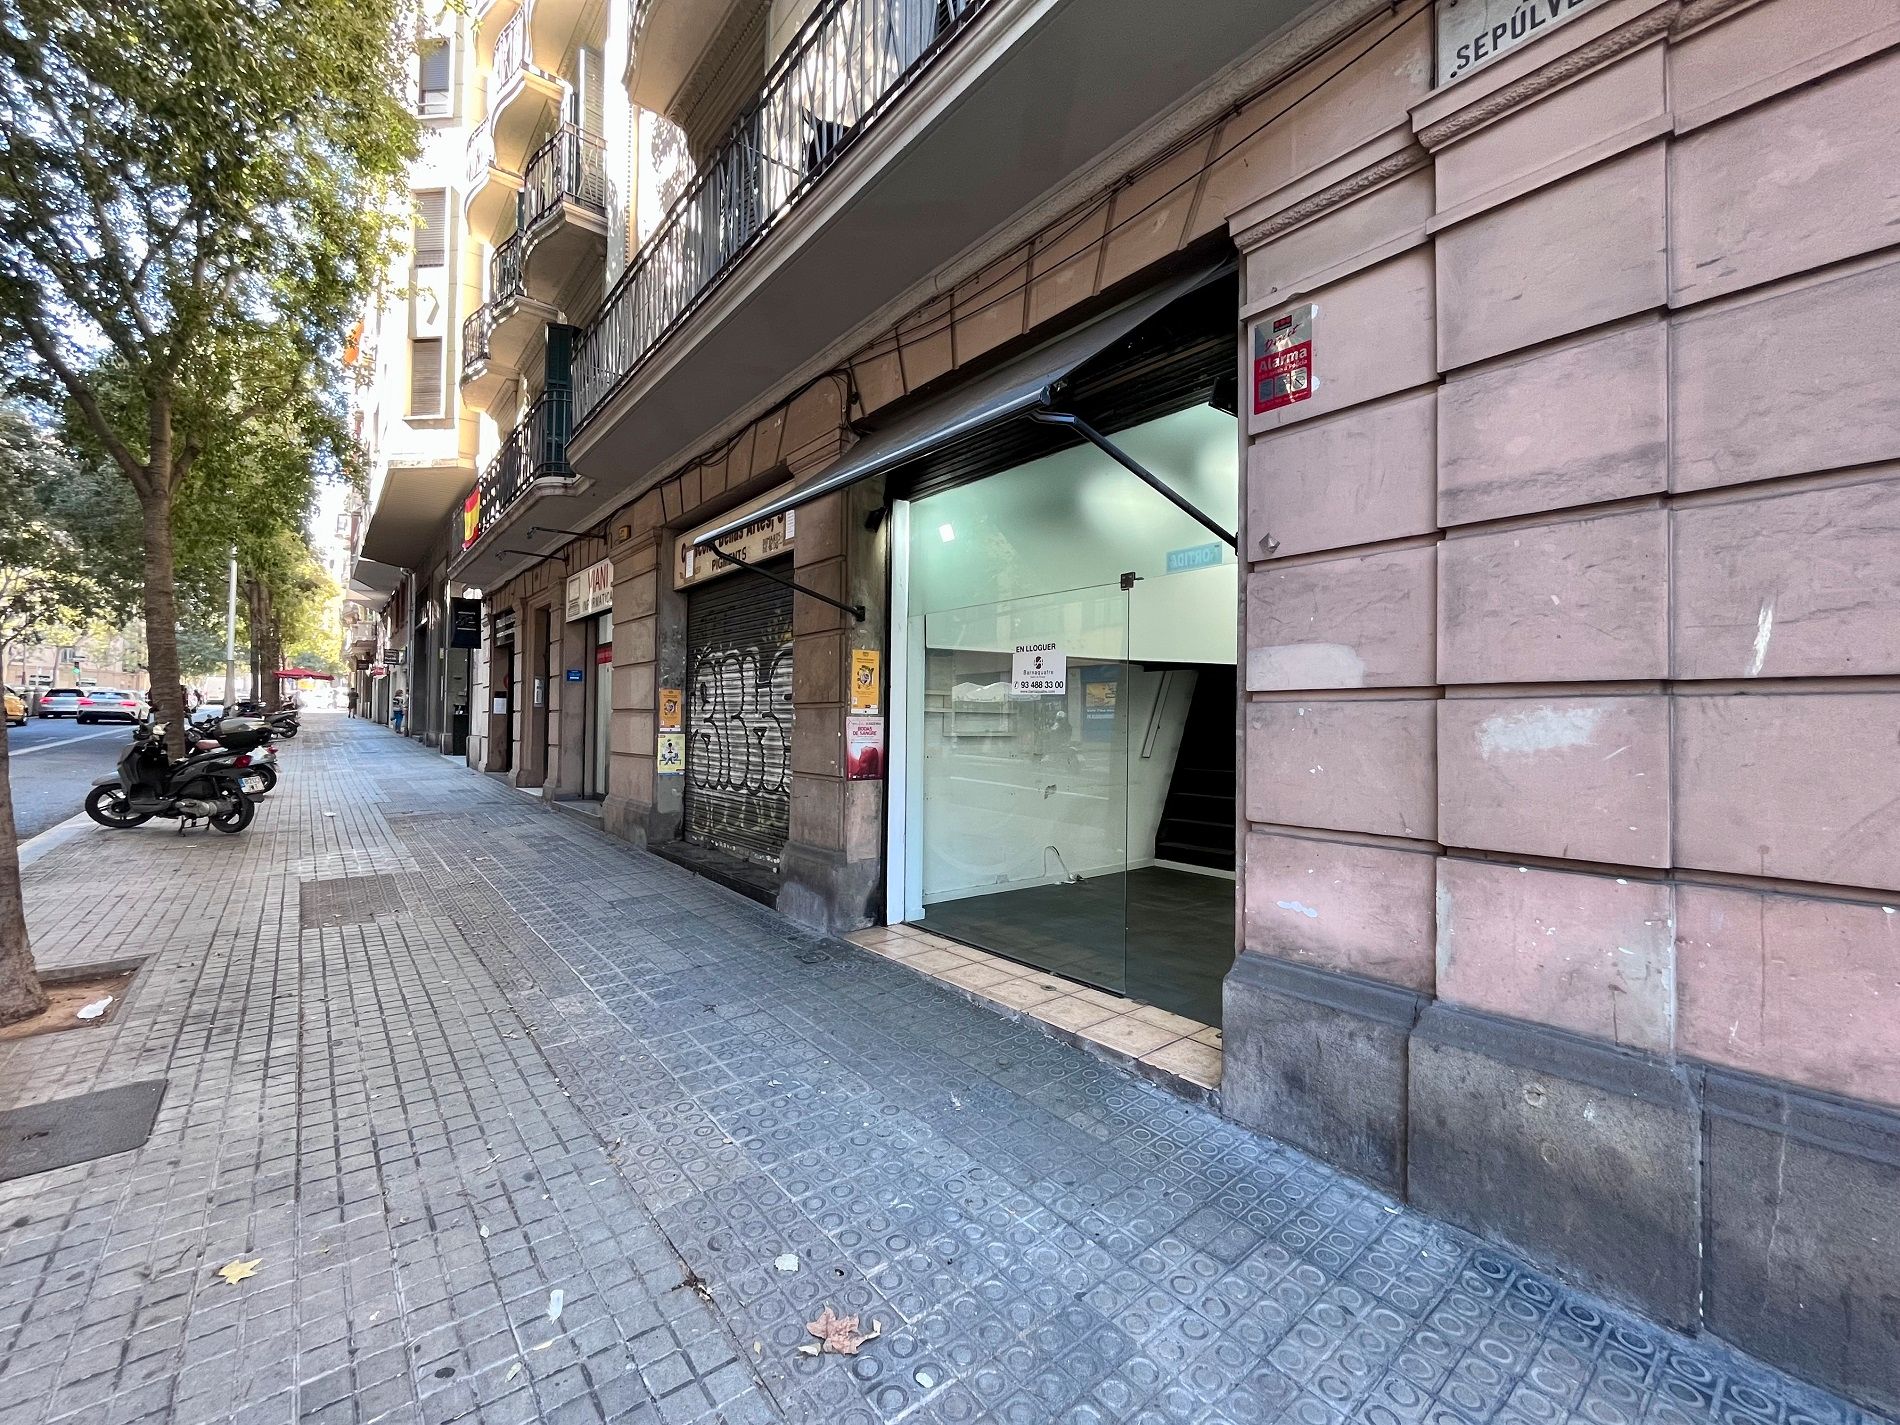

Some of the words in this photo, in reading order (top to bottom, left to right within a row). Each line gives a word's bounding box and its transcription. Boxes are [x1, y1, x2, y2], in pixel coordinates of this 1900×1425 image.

[1260, 348, 1308, 371] Alarma
[711, 546, 747, 572] PIGMNTS
[582, 590, 612, 612] INFRMATICA
[1025, 643, 1056, 652] LLOGUER
[1020, 681, 1029, 689] 93
[1031, 681, 1043, 689] 488
[1044, 681, 1053, 689] 33
[1055, 680, 1064, 689] 00
